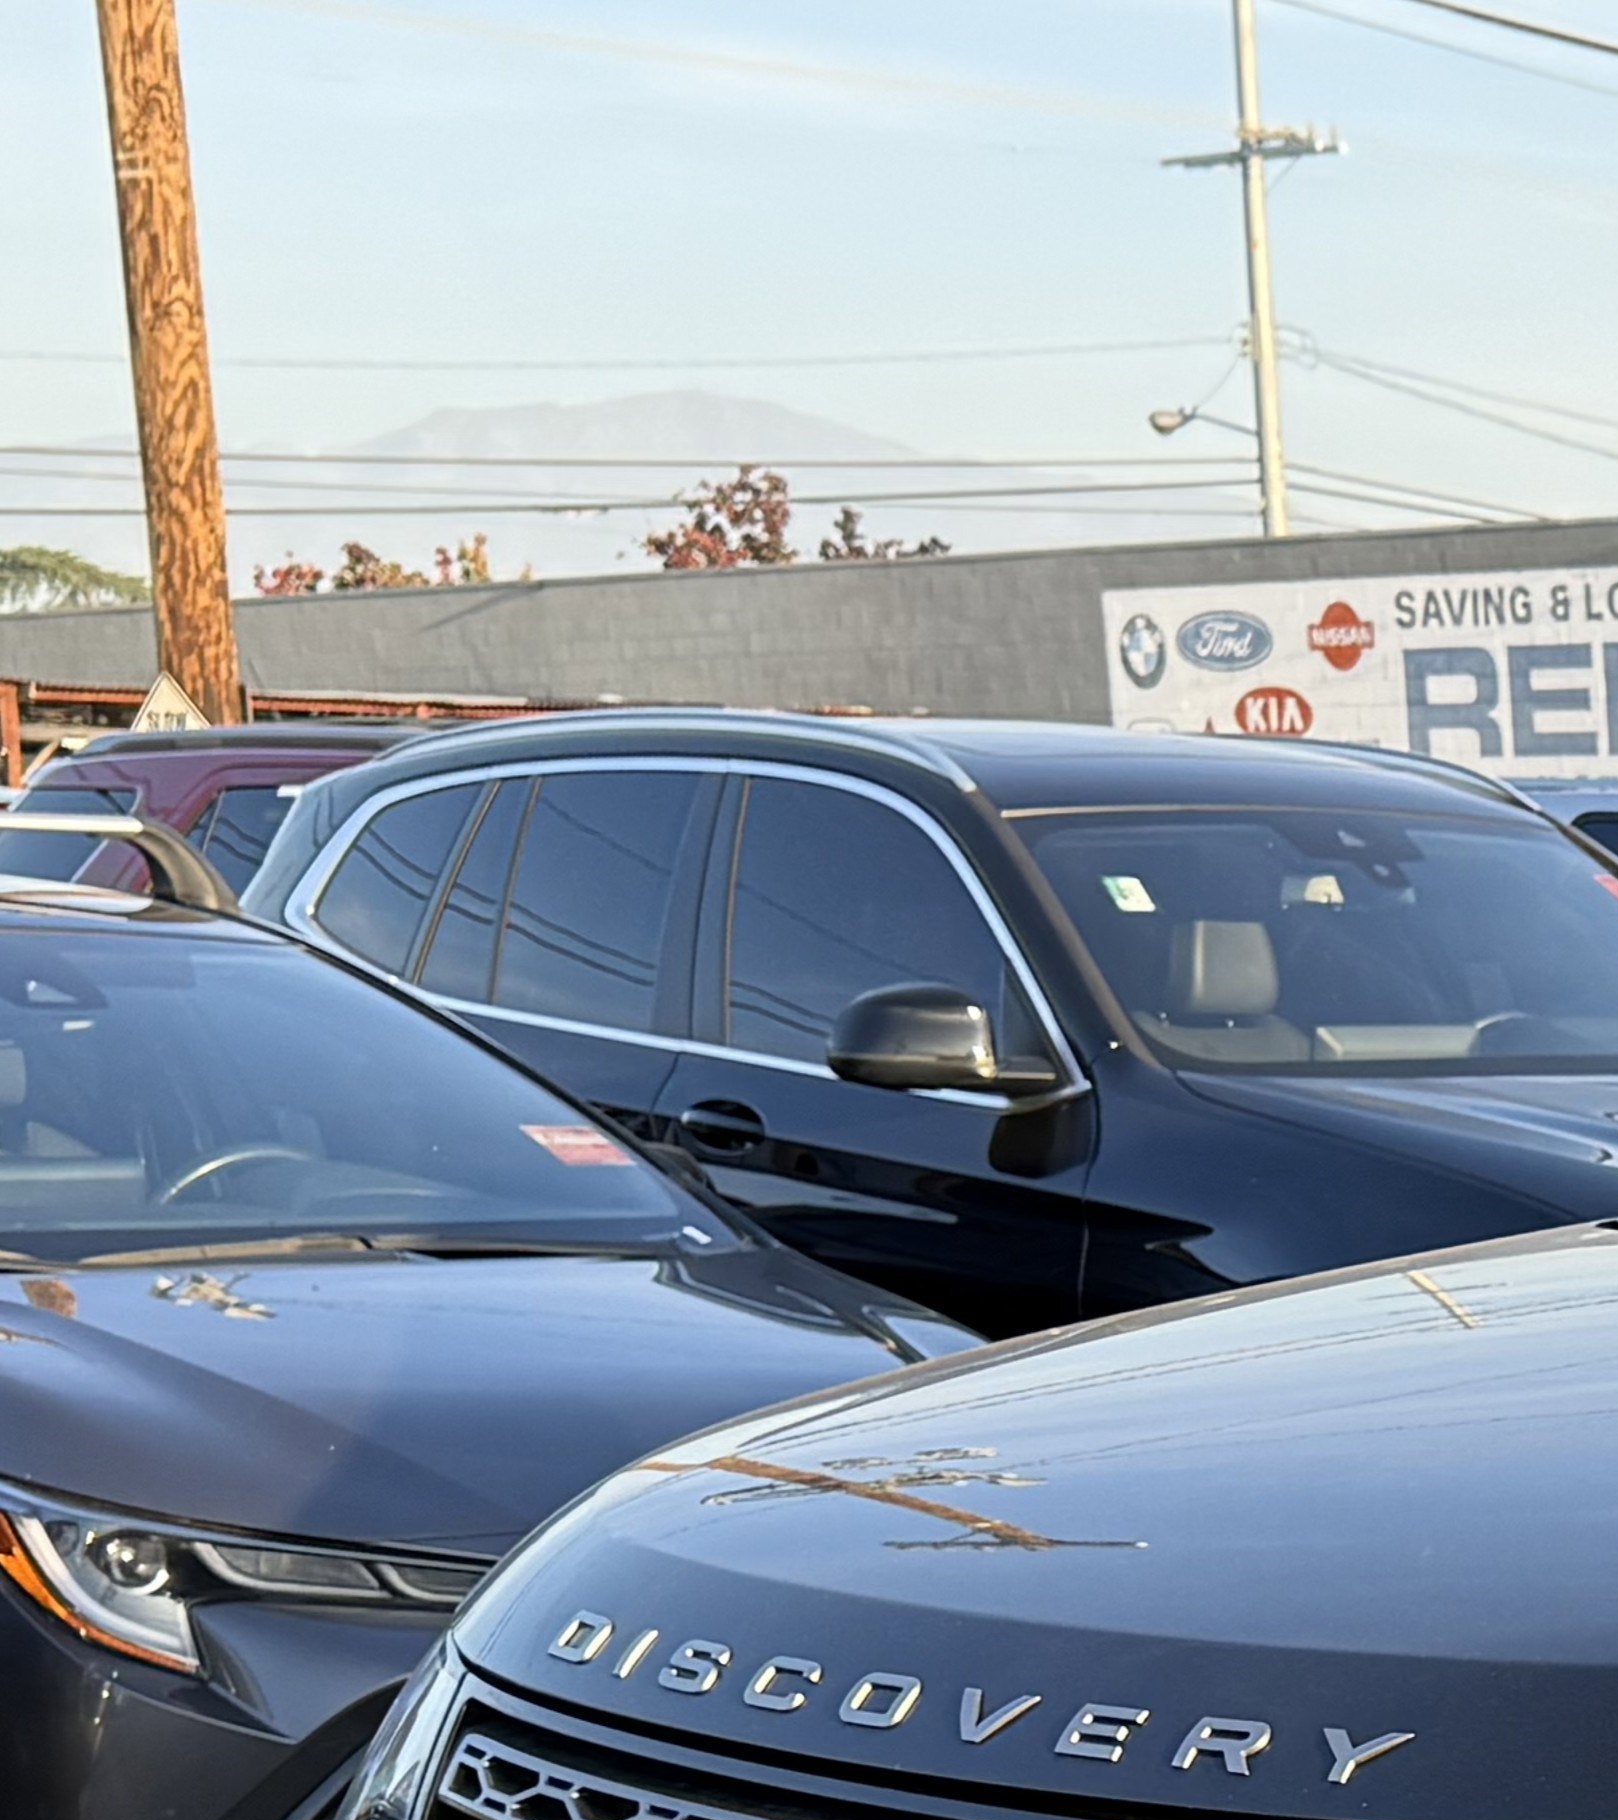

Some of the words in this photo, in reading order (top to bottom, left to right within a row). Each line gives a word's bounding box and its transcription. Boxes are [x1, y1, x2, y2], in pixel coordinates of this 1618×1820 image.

[1394, 585, 1533, 629] SAVING
[1550, 584, 1570, 622] &
[1195, 620, 1253, 658] Ford
[1311, 626, 1374, 646] NISSAN
[1244, 697, 1305, 732] KIA
[547, 1610, 1415, 1785] DISCOVERY
